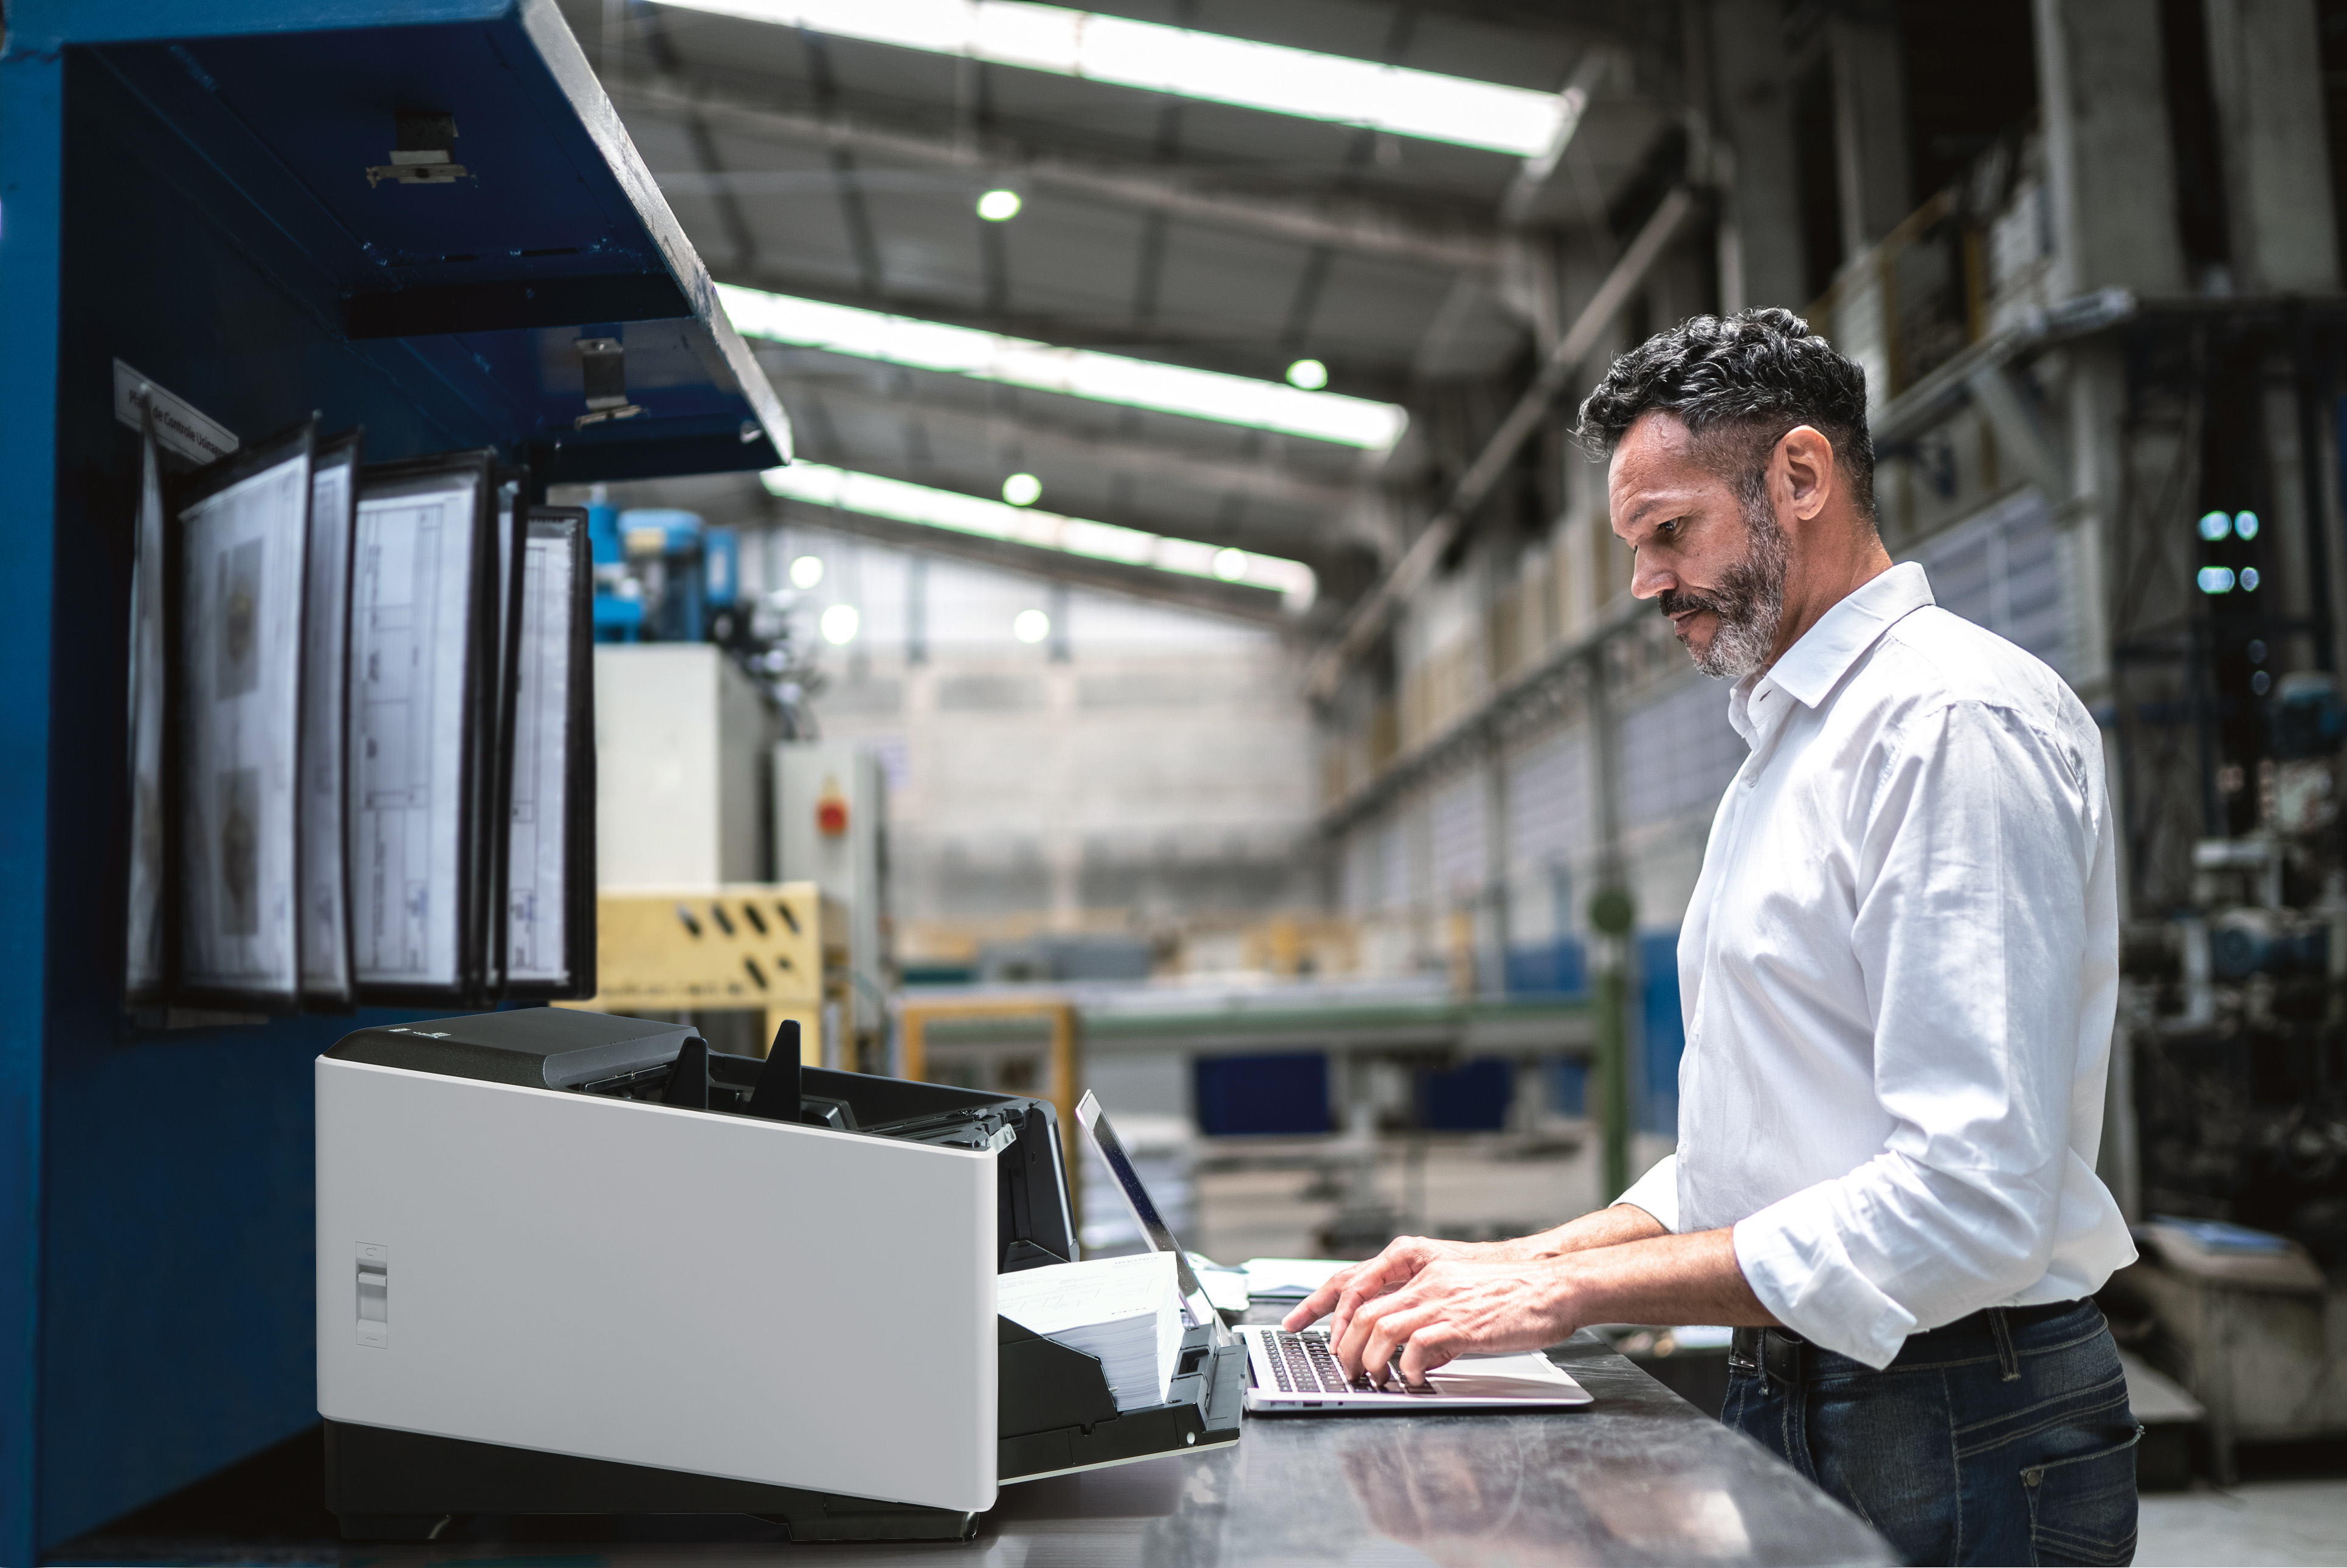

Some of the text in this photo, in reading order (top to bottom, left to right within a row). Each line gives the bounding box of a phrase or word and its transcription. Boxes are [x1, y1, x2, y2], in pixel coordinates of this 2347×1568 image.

[153, 405, 163, 422] de
[164, 411, 196, 441] Controle
[196, 432, 227, 458] Usinage
